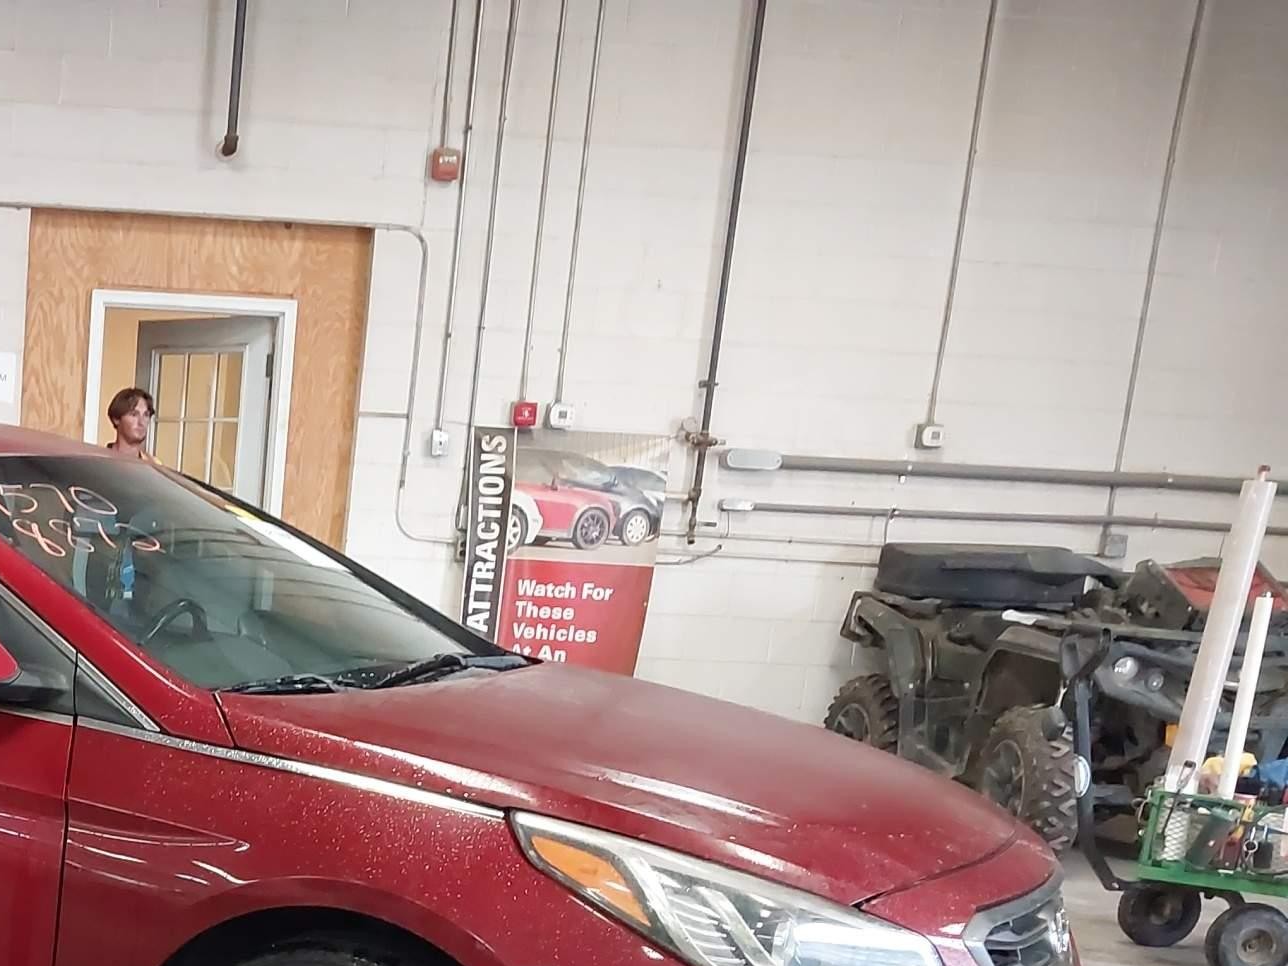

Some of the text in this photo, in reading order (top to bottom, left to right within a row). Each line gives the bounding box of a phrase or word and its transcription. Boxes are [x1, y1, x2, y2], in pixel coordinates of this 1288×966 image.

[467, 434, 507, 633] ATTRACTIONS
[517, 579, 614, 601] Watch For
[515, 601, 575, 620] These
[513, 622, 597, 643] Vehicles
[536, 645, 568, 662] An
